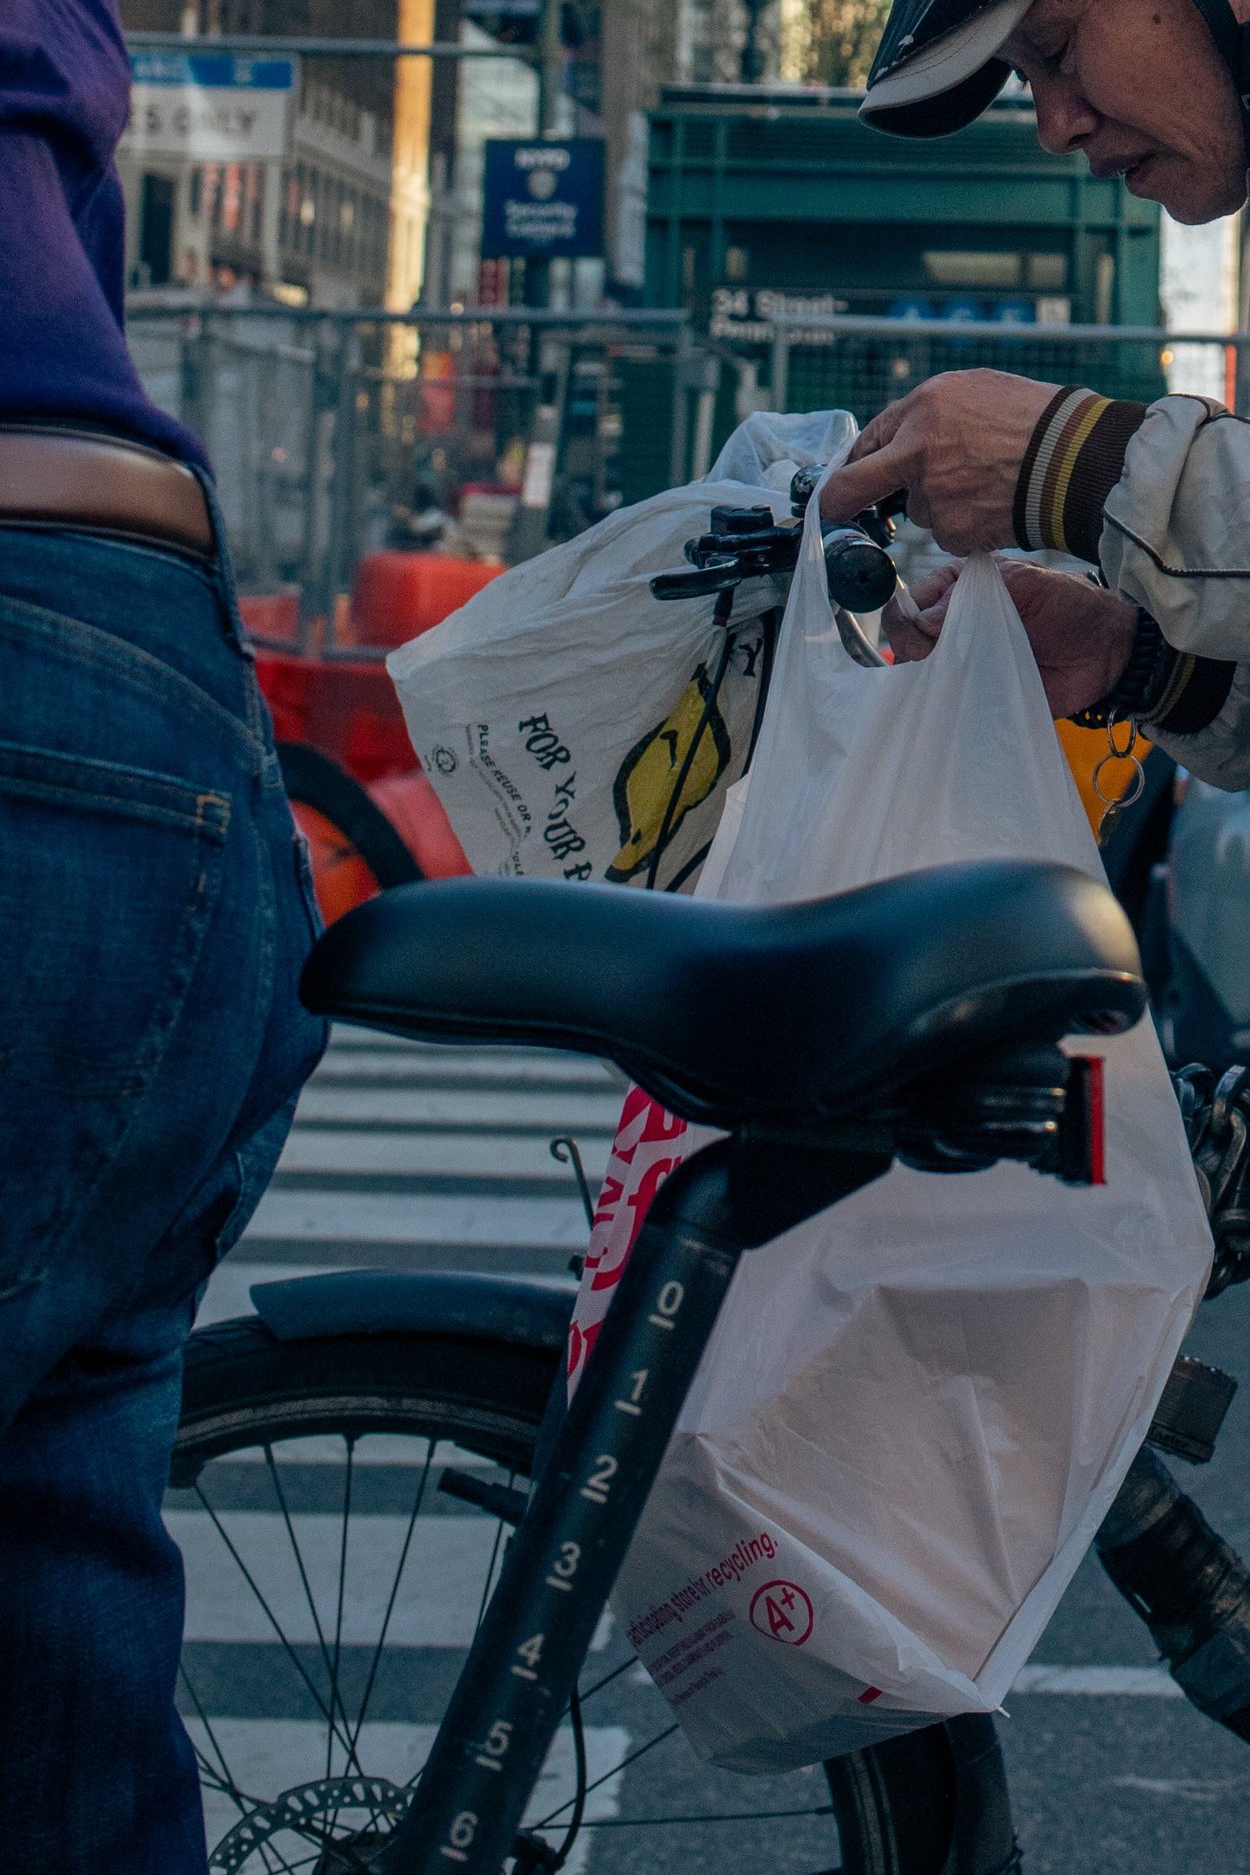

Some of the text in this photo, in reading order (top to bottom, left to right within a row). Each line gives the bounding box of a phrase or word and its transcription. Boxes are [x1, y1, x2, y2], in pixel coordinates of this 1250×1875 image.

[518, 711, 571, 771] FOR
[477, 724, 496, 768] PLEASE
[493, 768, 523, 803] REUSE
[517, 800, 532, 823] OR
[543, 770, 586, 861] YOUR
[656, 1280, 684, 1317] 0
[629, 1368, 650, 1402] 1
[586, 1454, 618, 1492] 2
[553, 1541, 581, 1576] 3
[706, 1532, 778, 1590] recycling.
[516, 1633, 545, 1668] 4
[485, 1719, 514, 1757] 5
[449, 1810, 479, 1848] 6
